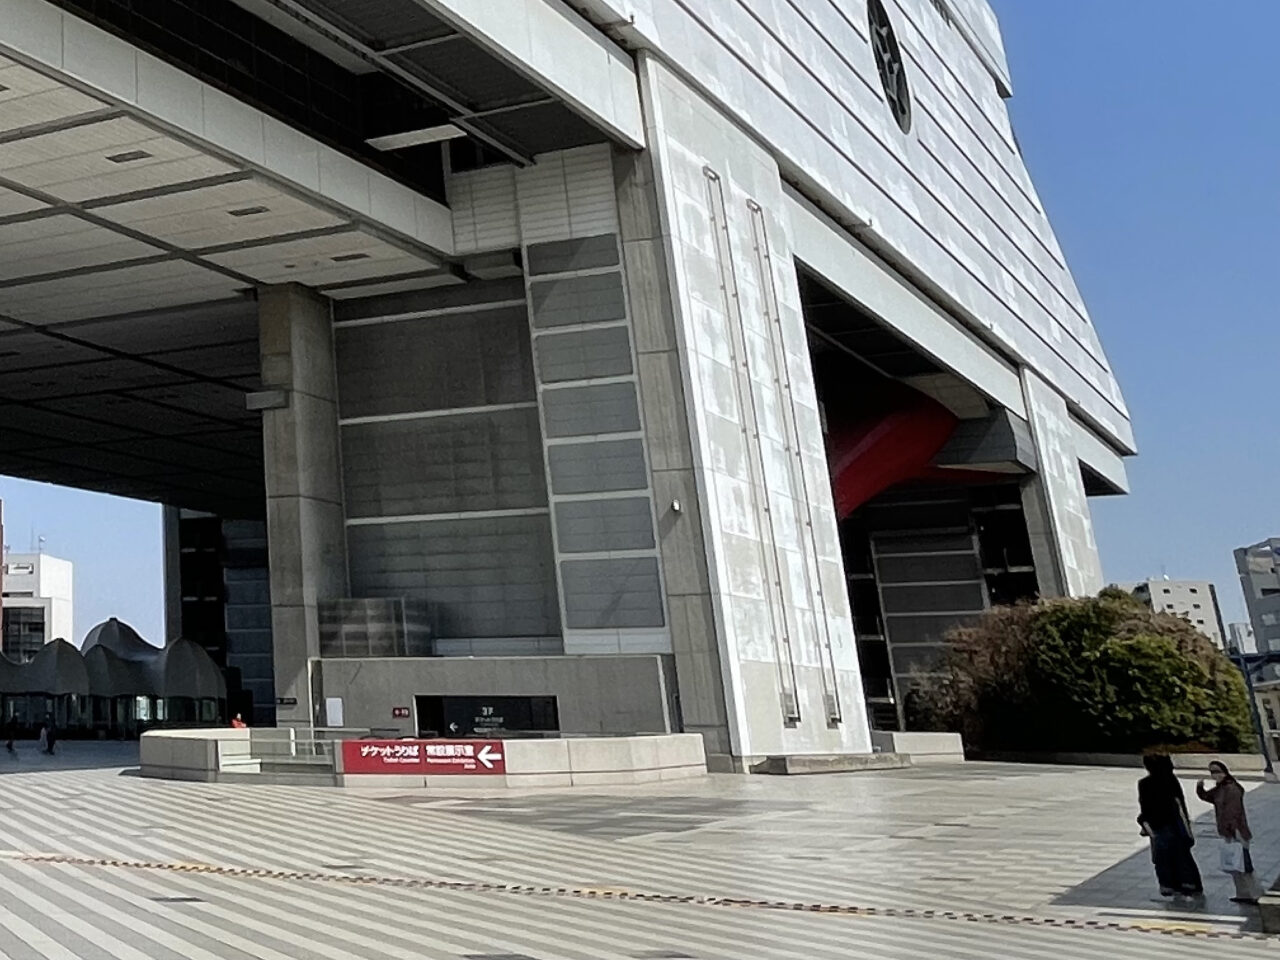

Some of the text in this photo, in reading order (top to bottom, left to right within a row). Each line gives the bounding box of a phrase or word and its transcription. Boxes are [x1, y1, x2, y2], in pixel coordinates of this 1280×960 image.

[361, 745, 419, 756] チケットうりば
